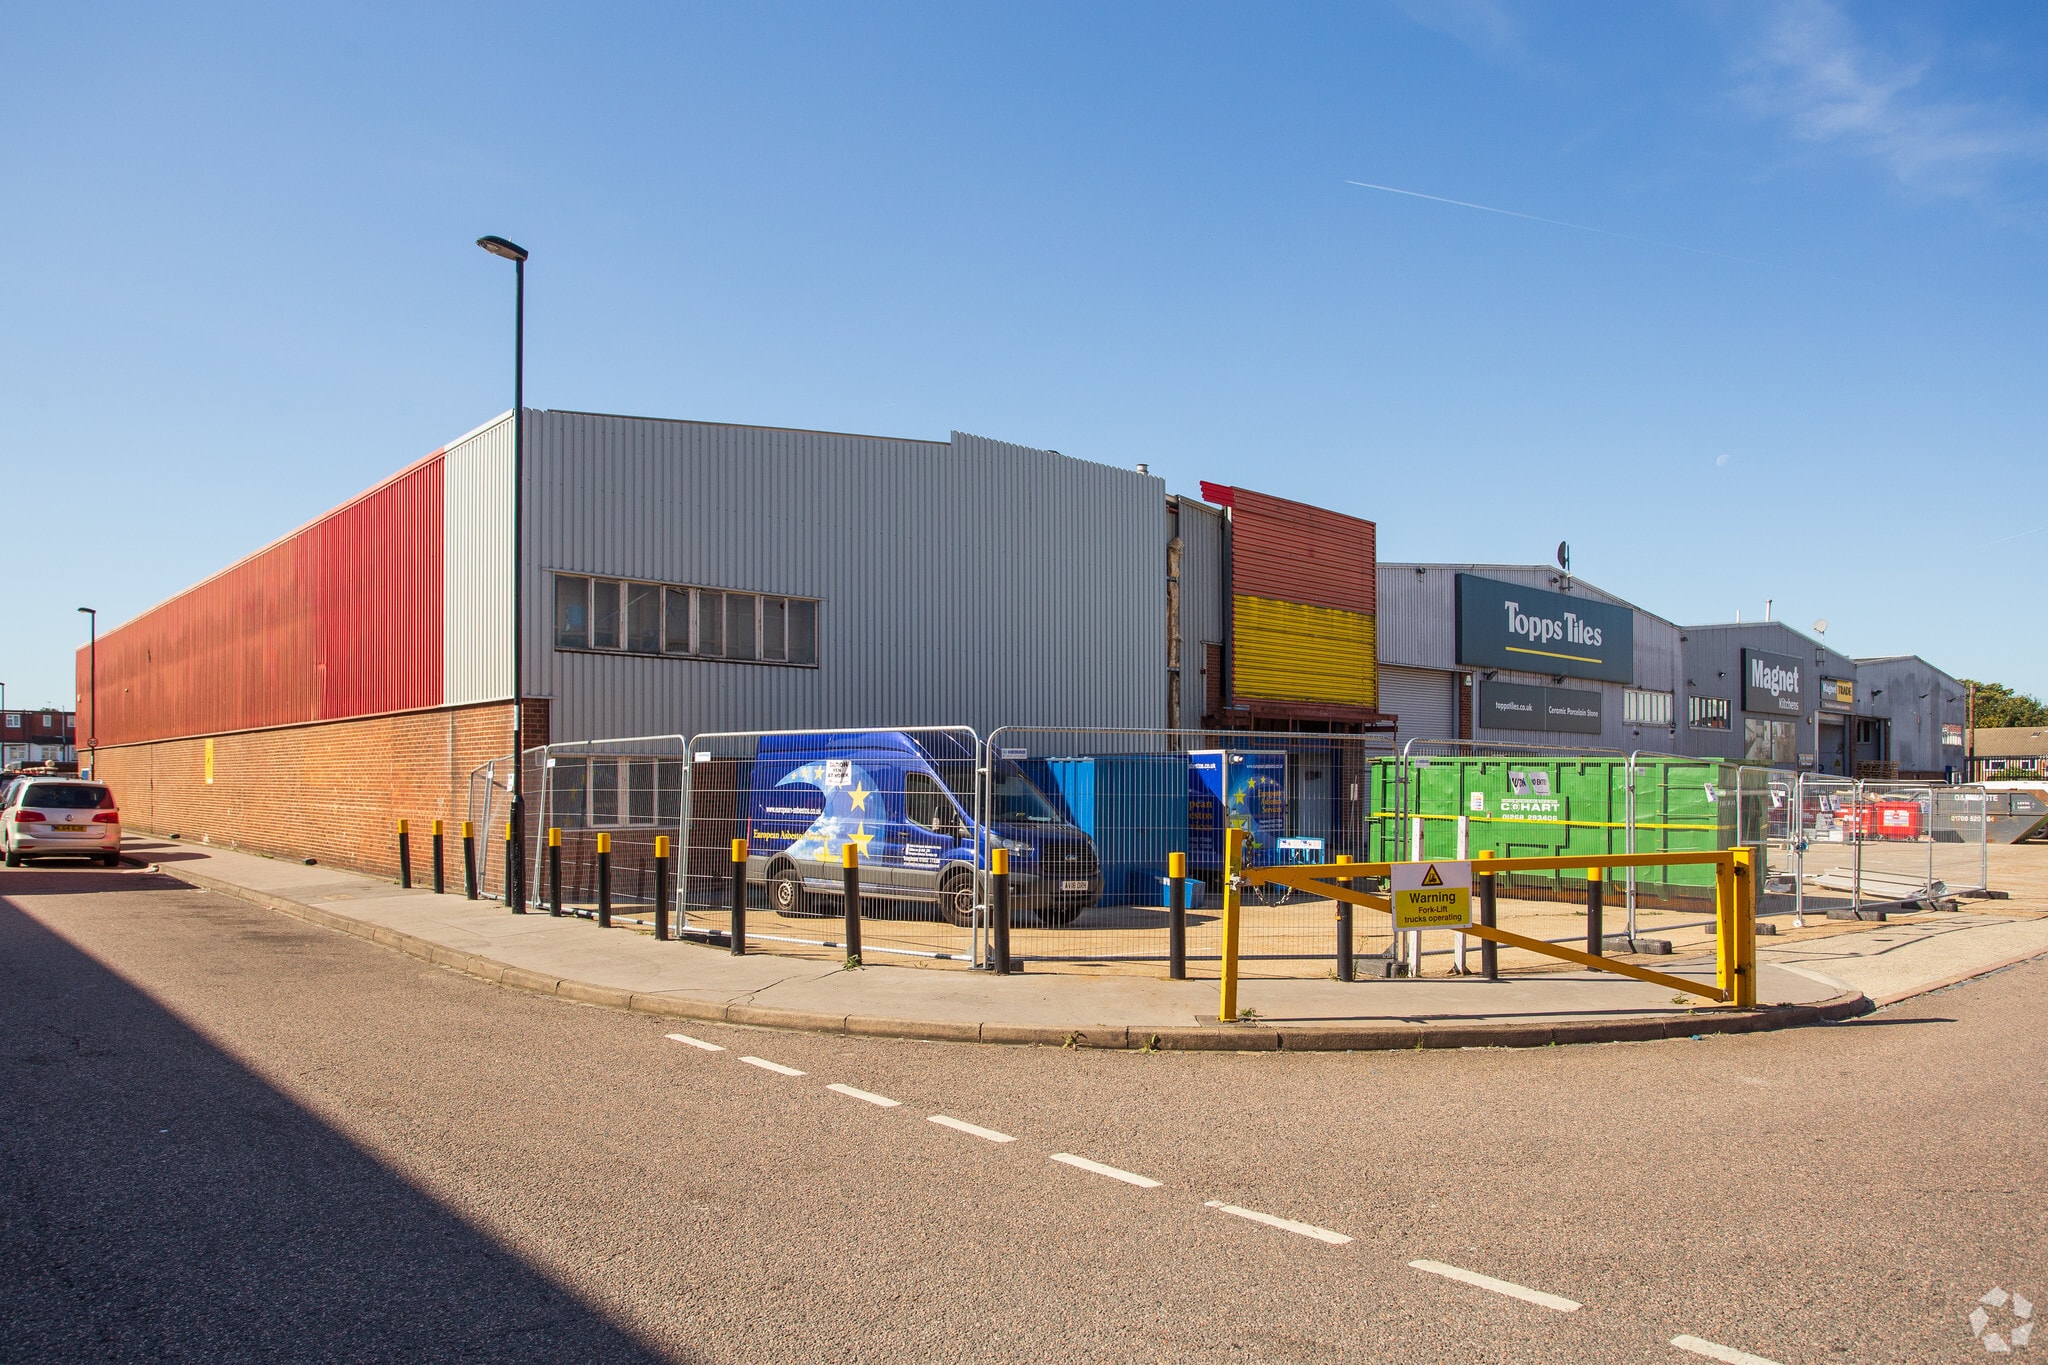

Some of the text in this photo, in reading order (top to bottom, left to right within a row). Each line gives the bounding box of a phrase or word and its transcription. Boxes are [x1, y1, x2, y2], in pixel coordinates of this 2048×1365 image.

[1504, 600, 1602, 647] Topps Tiles
[1752, 659, 1799, 697] Magnet
[1837, 685, 1852, 696] TRADE
[1495, 701, 1533, 712] toppstiles.co.uk
[1778, 697, 1799, 711] Kitchens
[1548, 705, 1599, 717] Ceramic Porcelain Stone
[1189, 800, 1213, 810] pean
[753, 829, 780, 841] European
[1409, 892, 1456, 904] Warning
[1418, 905, 1448, 914] Fork-Lift
[1428, 913, 1462, 923] operating
